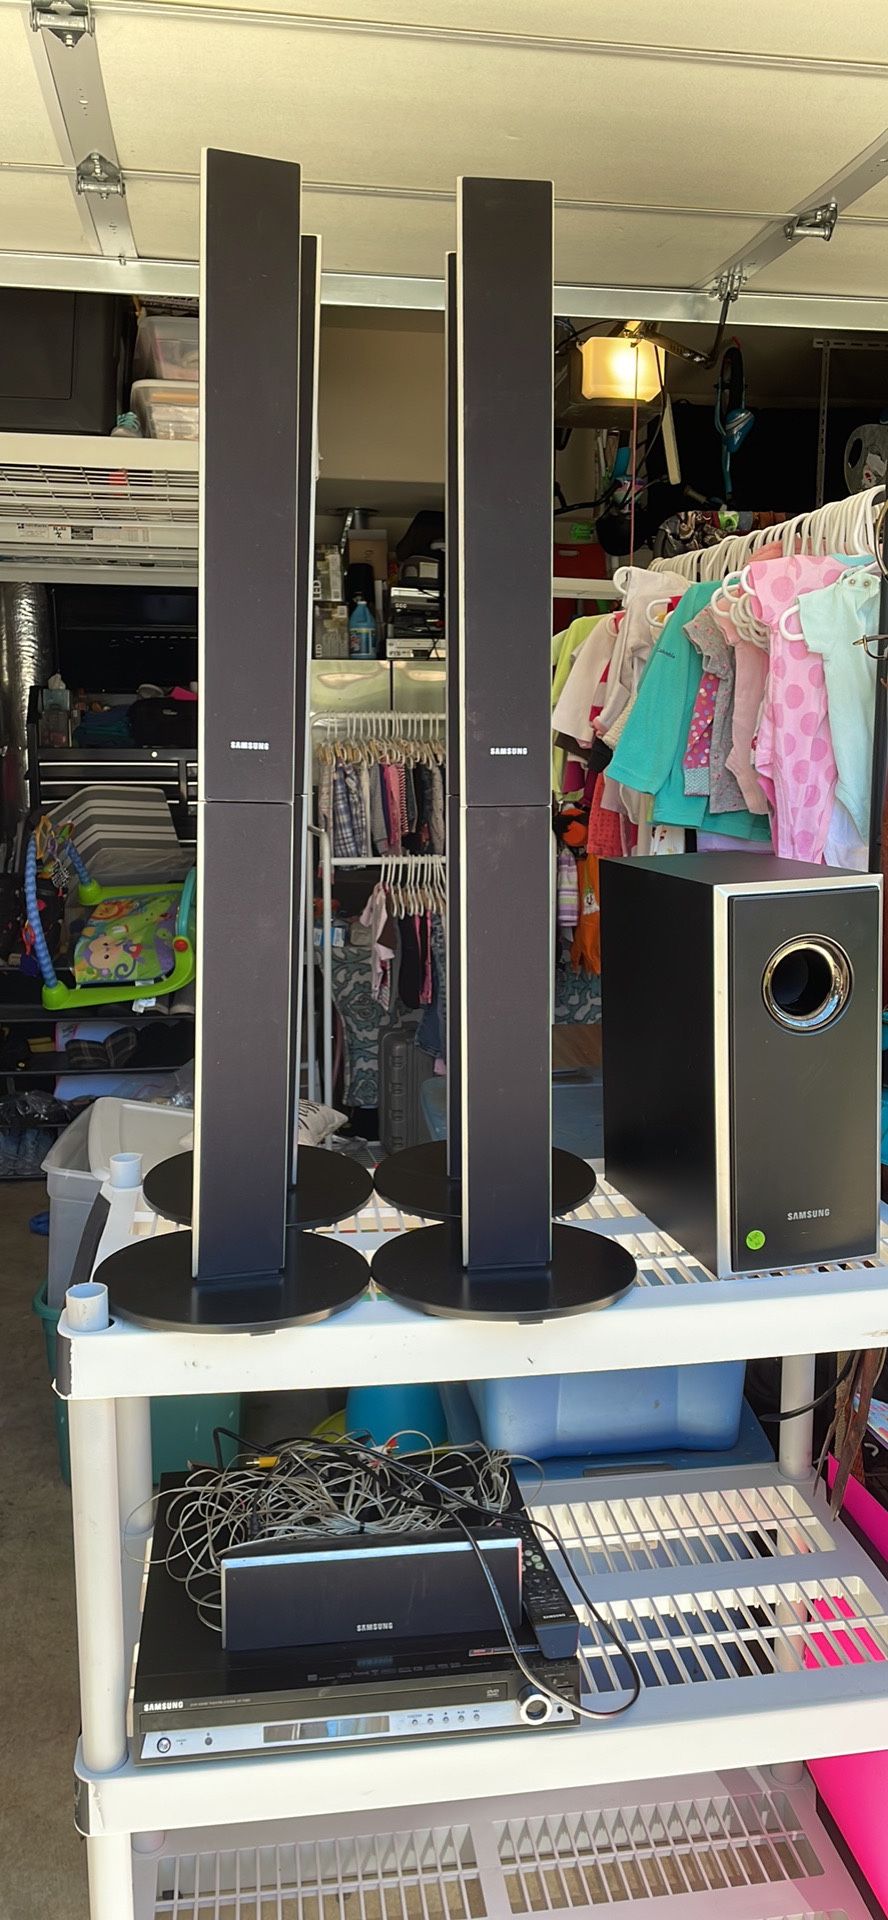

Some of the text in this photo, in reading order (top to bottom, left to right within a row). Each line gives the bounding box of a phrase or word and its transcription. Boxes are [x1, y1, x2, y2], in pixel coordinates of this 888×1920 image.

[230, 741, 270, 751] SAMSUNG
[490, 747, 528, 755] SAMSUNG
[787, 1208, 830, 1221] SAMSUNG
[356, 1622, 394, 1632] SAMSUNG
[143, 1700, 184, 1712] SAMSUNG
